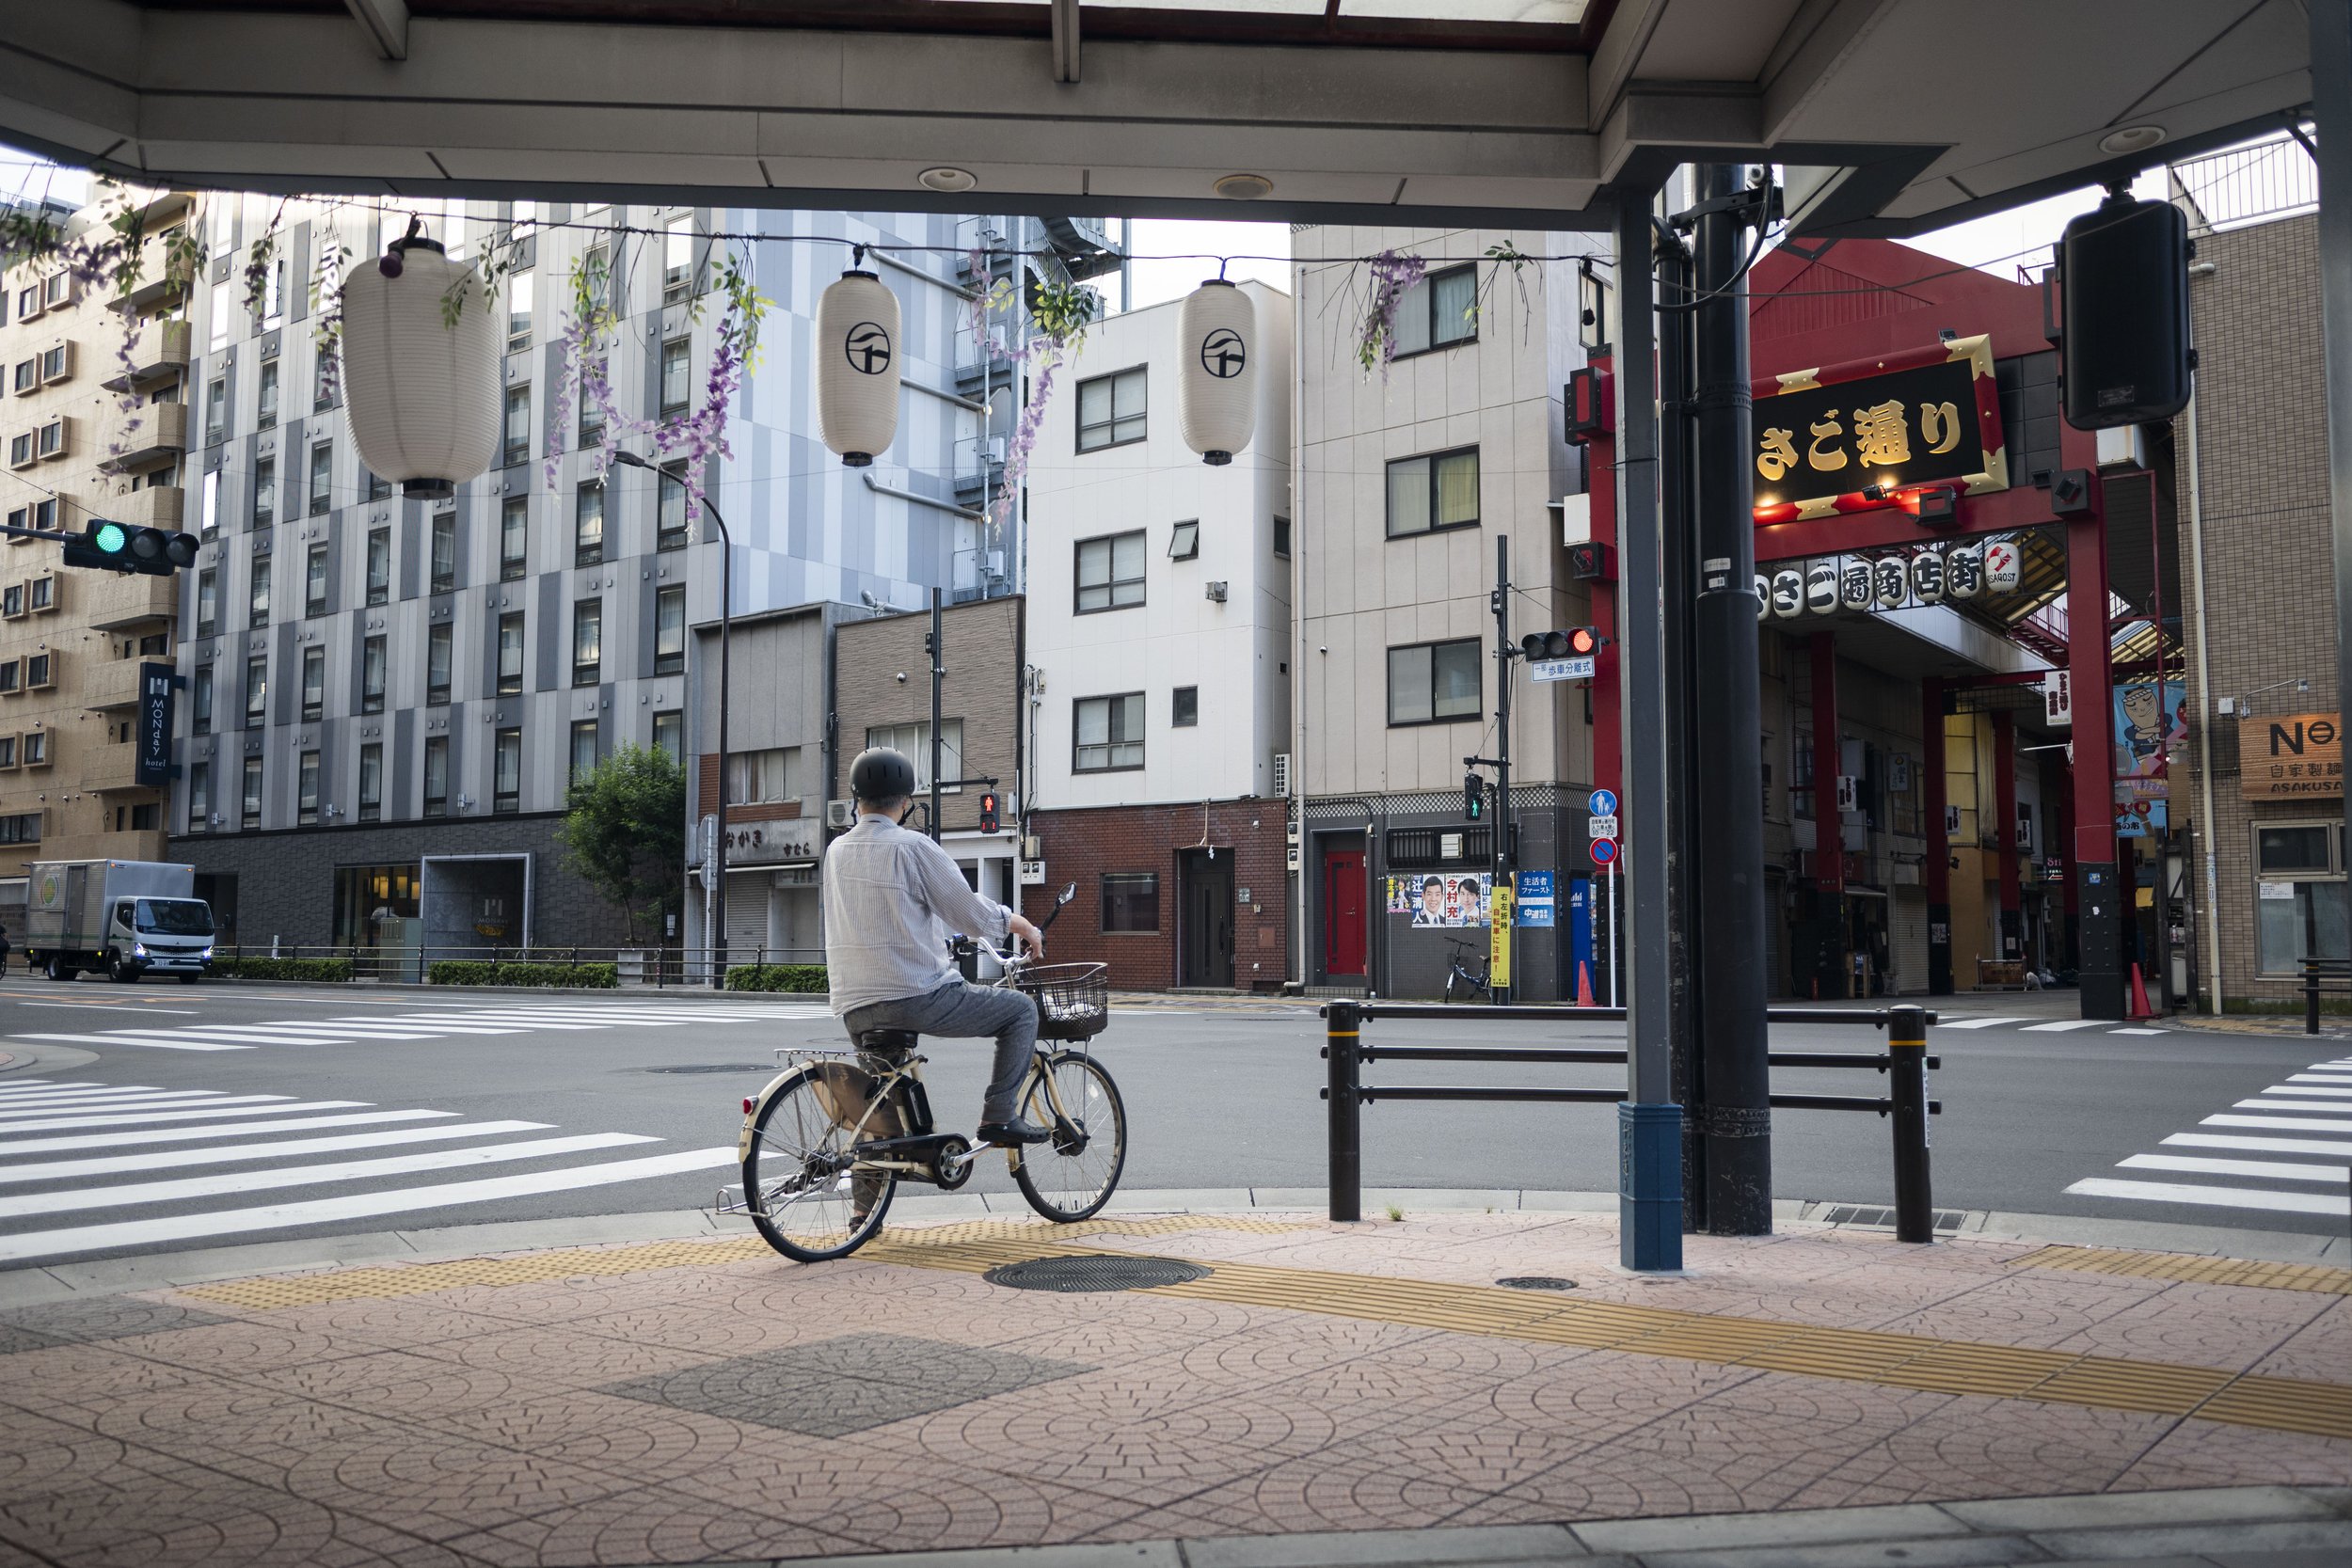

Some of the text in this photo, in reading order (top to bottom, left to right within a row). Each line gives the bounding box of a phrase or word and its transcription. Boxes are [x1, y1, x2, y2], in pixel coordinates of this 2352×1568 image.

[2271, 782, 2343, 793] ASAKUSA
[1524, 877, 1548, 886] 生活者
